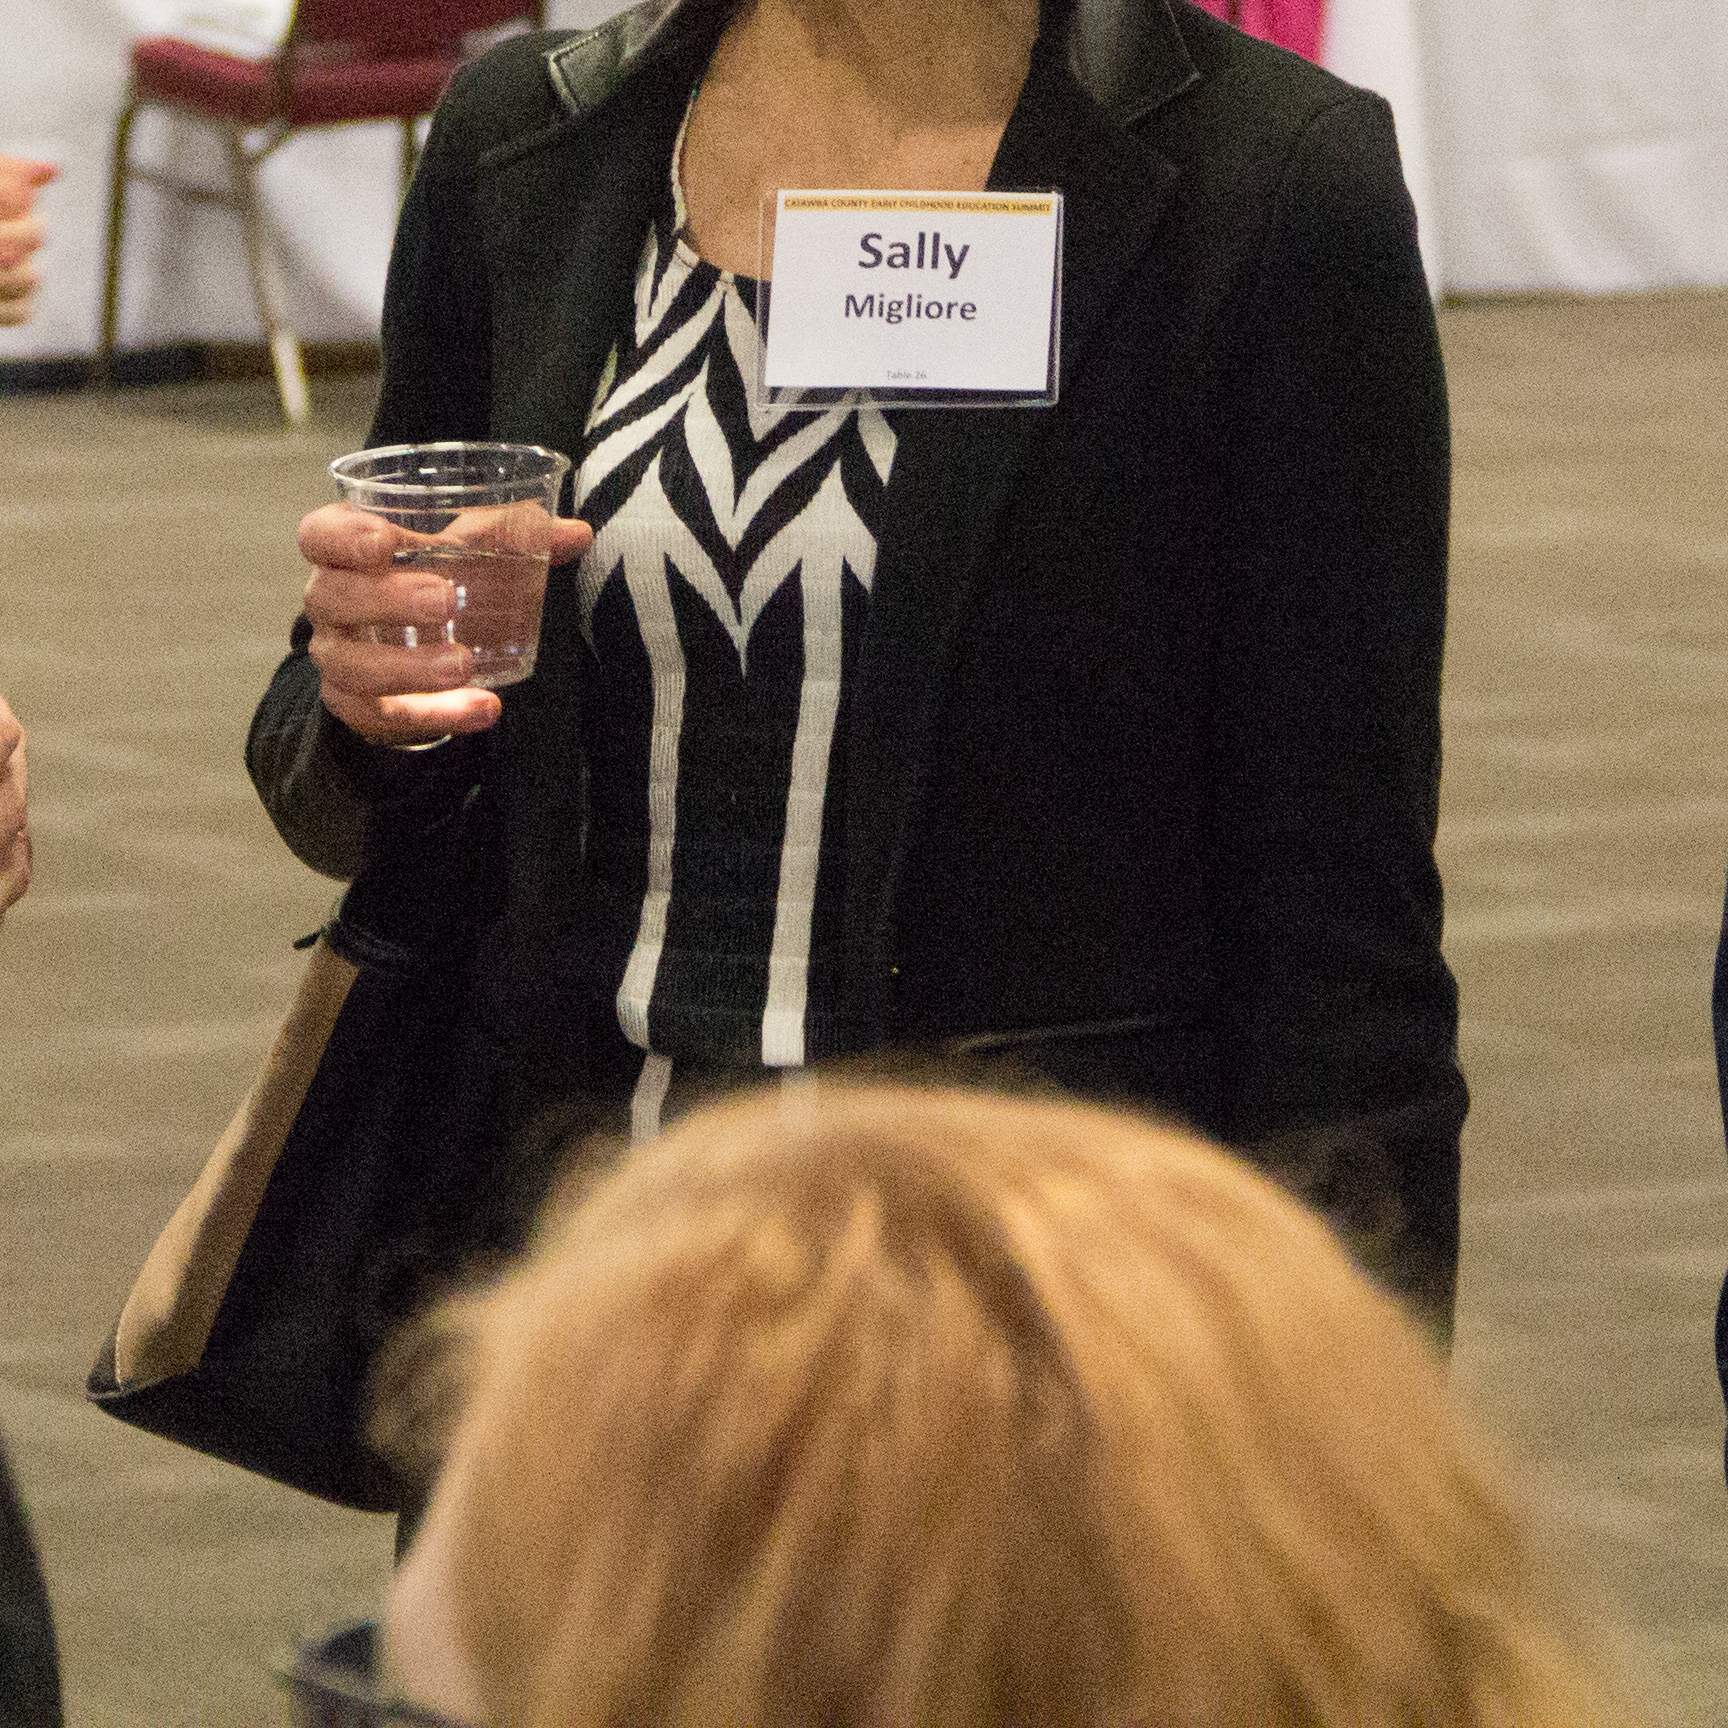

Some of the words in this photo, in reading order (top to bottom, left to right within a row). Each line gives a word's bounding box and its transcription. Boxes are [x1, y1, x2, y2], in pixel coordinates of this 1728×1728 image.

[785, 199, 828, 208] CATAWBA
[831, 200, 868, 208] COUNTY
[870, 200, 897, 209] EARLY
[900, 201, 954, 210] CHILDHOOD
[956, 202, 1009, 211] EDUCATION
[1011, 203, 1051, 212] SUMMIT
[859, 232, 969, 279] Sally
[845, 294, 976, 324] Migliore
[886, 370, 913, 381] Table
